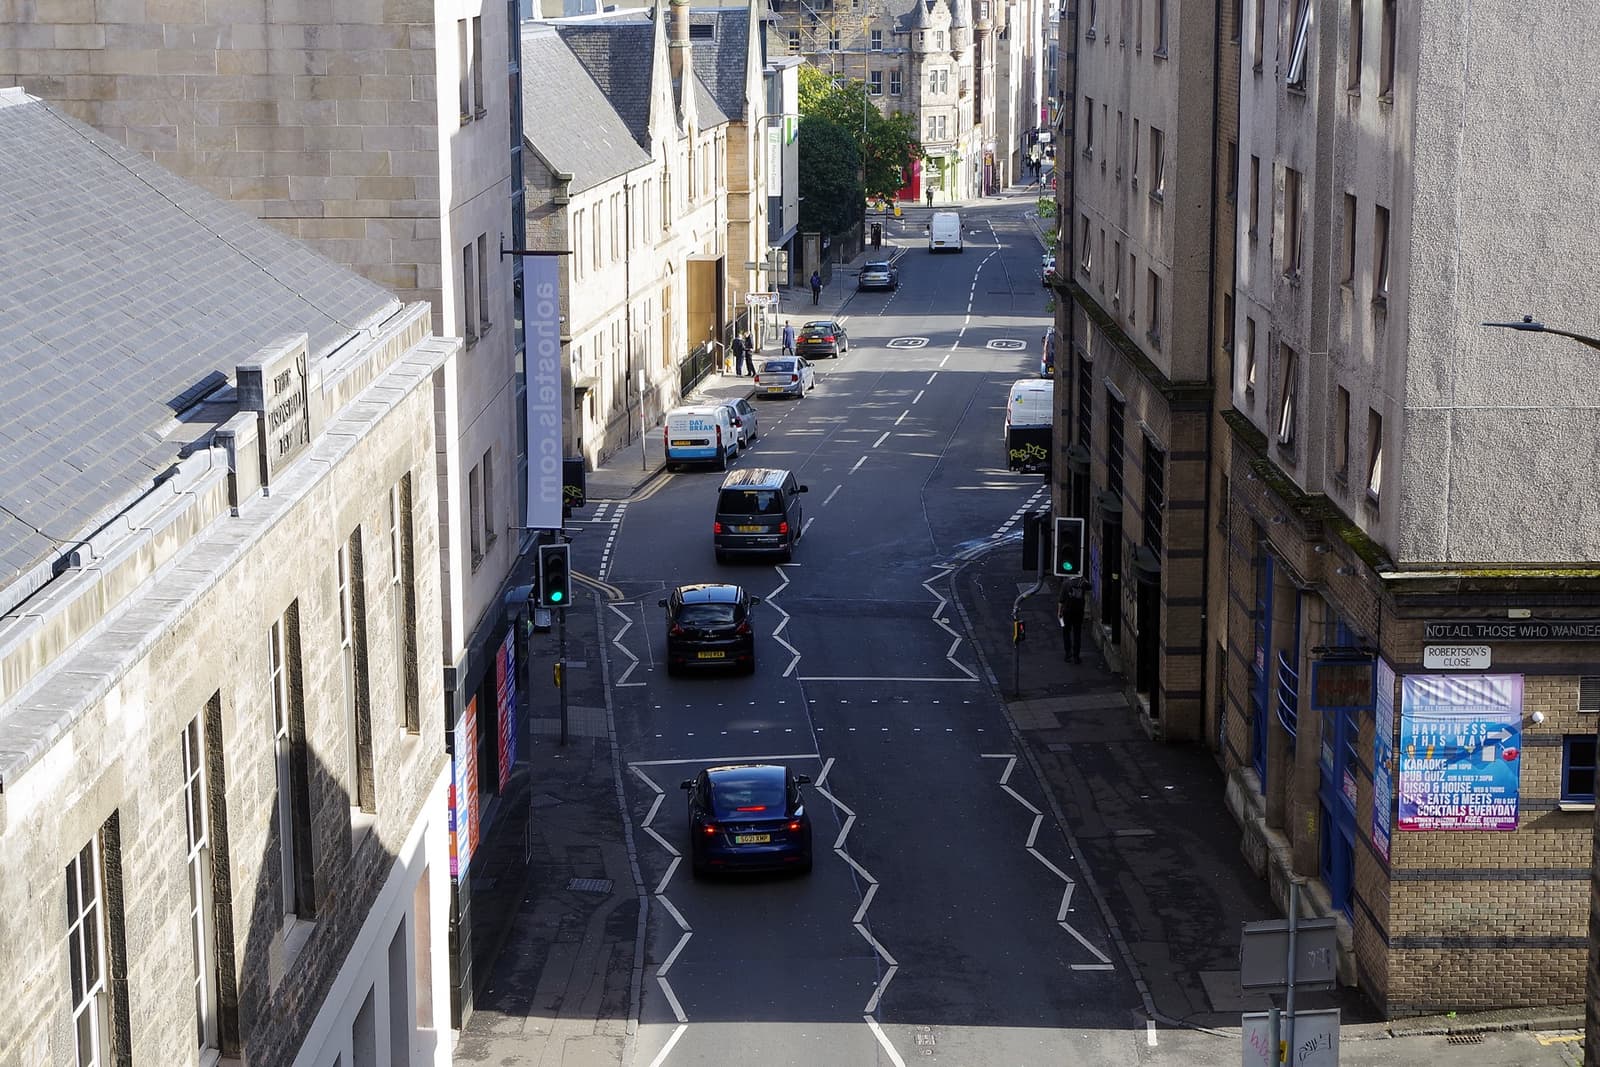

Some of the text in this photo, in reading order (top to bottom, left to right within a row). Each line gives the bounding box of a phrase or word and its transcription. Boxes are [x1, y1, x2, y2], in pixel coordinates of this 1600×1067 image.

[1426, 626, 1450, 637] NOT
[1450, 626, 1473, 637] ALL
[1477, 625, 1516, 637] THOSE
[1520, 625, 1548, 637] WHO
[1428, 647, 1487, 656] ROBERTSON'S
[1443, 658, 1471, 667] CLOSE
[1412, 724, 1487, 734] HAPPINESS
[1412, 736, 1486, 746] THIS WAY
[1404, 759, 1447, 770] KARAOKE
[1404, 770, 1422, 782] PUB
[1424, 770, 1446, 782] QUIZ
[1404, 782, 1430, 793] DISCO
[1433, 782, 1439, 793] &
[1442, 782, 1472, 793] HOUSE
[1428, 794, 1451, 804] EATS
[1453, 794, 1459, 804] &
[1462, 794, 1492, 804] MEETS
[1417, 805, 1516, 816] COCKTAILS EVERYDAY
